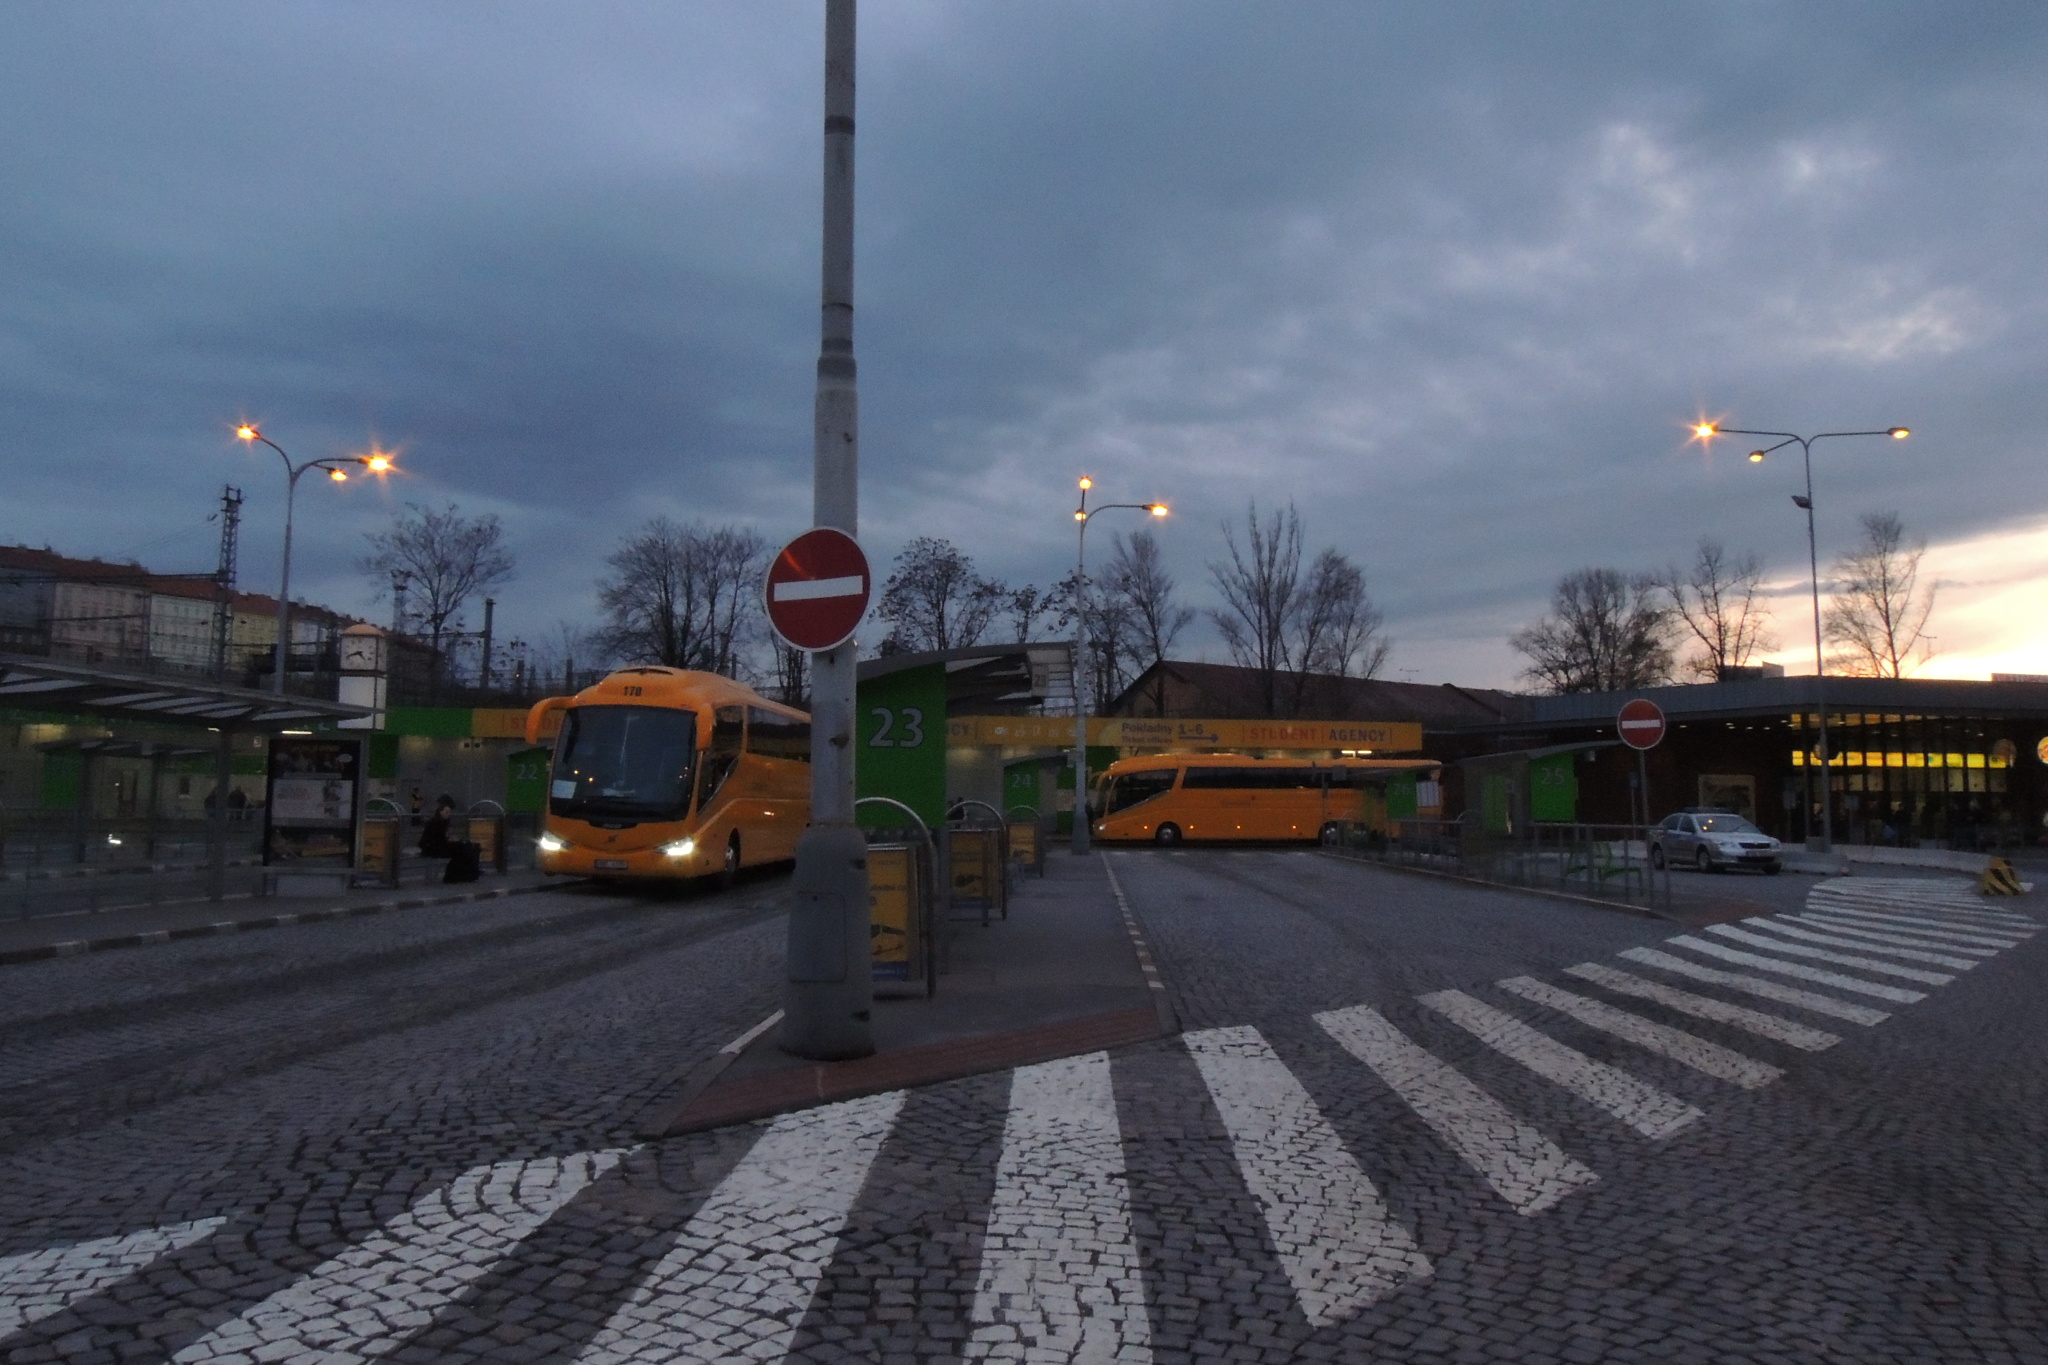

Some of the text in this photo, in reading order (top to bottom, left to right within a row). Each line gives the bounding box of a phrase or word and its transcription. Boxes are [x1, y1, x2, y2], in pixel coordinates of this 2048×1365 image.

[869, 707, 924, 747] 23
[1122, 722, 1204, 735] Pokladny 1-6
[1249, 727, 1385, 742] STUDENT AGENCY
[516, 764, 538, 780] 22
[1540, 767, 1566, 785] 25
[1011, 773, 1032, 788] 24
